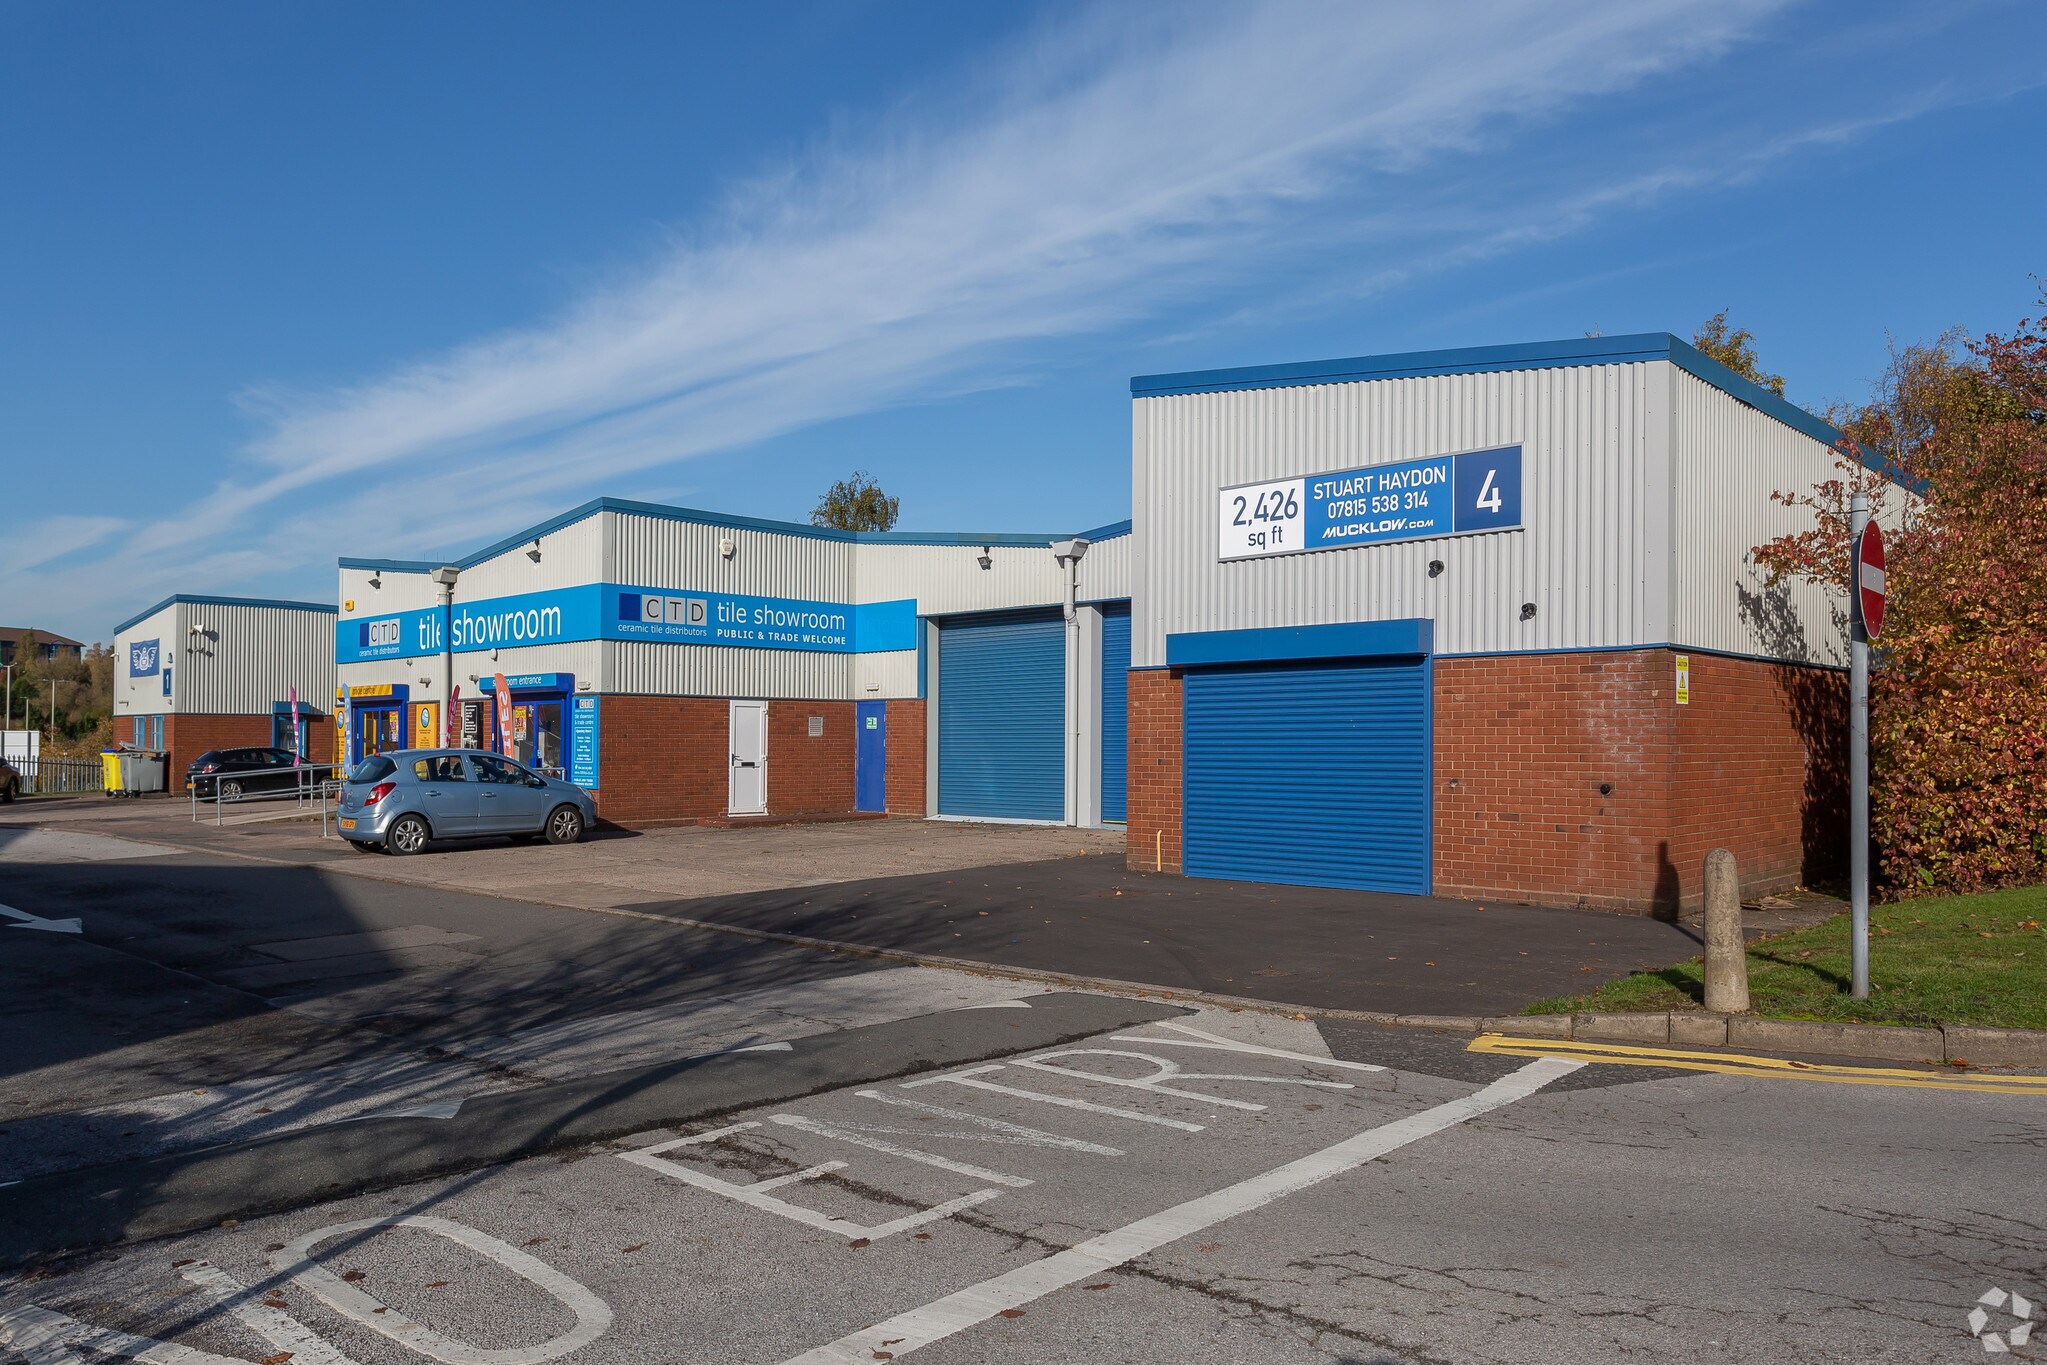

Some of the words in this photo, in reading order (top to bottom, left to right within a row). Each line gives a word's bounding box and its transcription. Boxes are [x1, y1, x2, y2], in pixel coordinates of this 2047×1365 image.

[1313, 475, 1374, 500] STUART
[1379, 465, 1446, 491] HAYDON
[1476, 469, 1502, 513] 4
[1232, 488, 1299, 527] 2,426
[1328, 499, 1366, 519] 07815
[1372, 495, 1398, 513] 538
[1404, 490, 1428, 509] 314
[1248, 532, 1266, 550] sq
[1272, 526, 1283, 544] ft
[646, 599, 704, 622] CTD
[717, 602, 747, 624] tile
[754, 604, 845, 630] showroom
[371, 623, 399, 642] CTD
[452, 605, 561, 646] showroom
[618, 623, 649, 633] ceramic
[650, 625, 663, 634] tile
[665, 626, 707, 637] distributors
[717, 629, 754, 640] PUBLIC
[758, 632, 765, 640] &
[768, 632, 799, 642] TRADE
[802, 634, 846, 645] WELCOME
[166, 674, 169, 689] 1
[518, 676, 542, 684] entrance
[614, 1020, 1388, 1241] ENTRY
